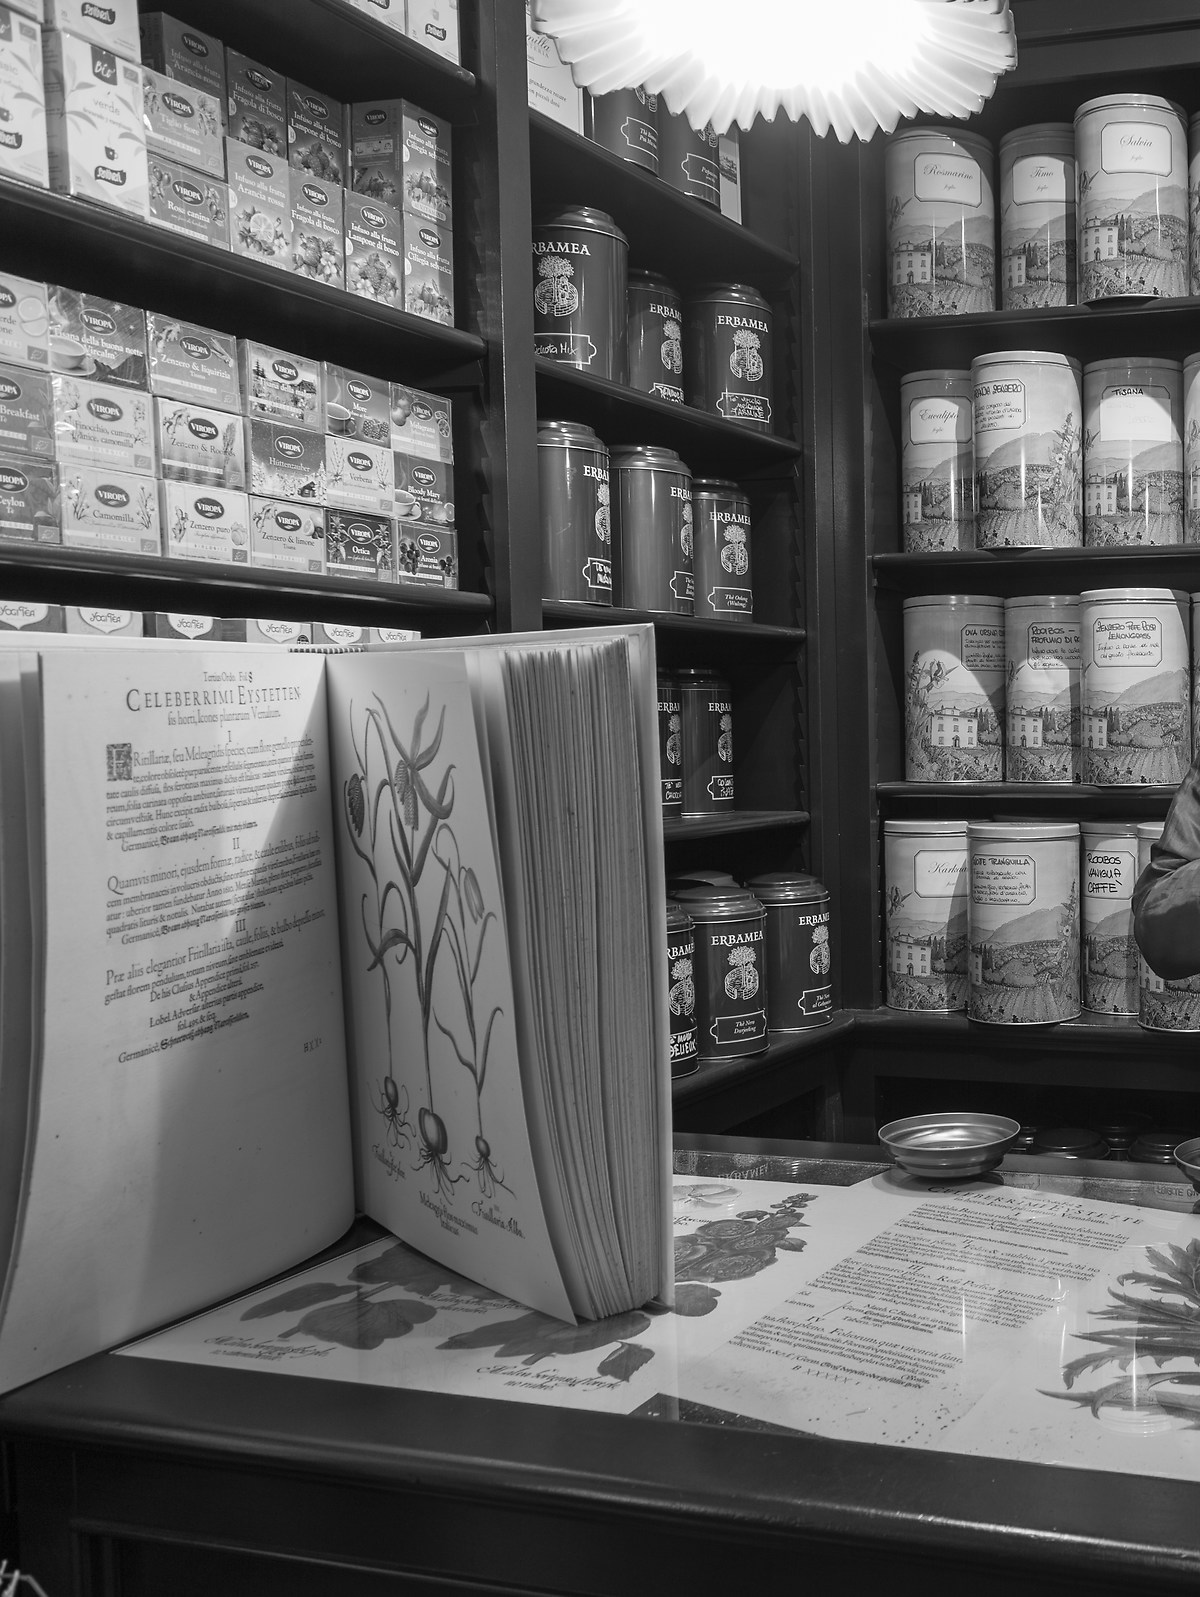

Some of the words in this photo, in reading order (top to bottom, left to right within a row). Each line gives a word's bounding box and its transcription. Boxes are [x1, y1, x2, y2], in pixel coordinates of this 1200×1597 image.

[165, 96, 192, 114] VIROPA
[291, 119, 318, 138] Lampone
[326, 134, 341, 148] bosco
[1120, 135, 1152, 147] Salvia
[248, 159, 271, 173] VIROPA
[924, 164, 973, 180] Rosmarino
[1030, 166, 1053, 178] Timo
[174, 184, 201, 200] VIROPA
[238, 184, 266, 200] Arancia
[303, 186, 326, 201] VIROPA
[168, 201, 185, 214] Rosa
[187, 209, 209, 223] canina
[363, 209, 384, 224] VIROPA
[292, 210, 314, 225] Fragola
[323, 222, 339, 235] bosco
[351, 223, 370, 235] Infuso
[349, 230, 376, 247] Lampone
[383, 244, 399, 256] bosco
[420, 232, 439, 245] VIROPA
[410, 244, 427, 256] Infuso
[533, 242, 591, 256] RBAMEA
[408, 252, 429, 266] Ciliegia
[83, 314, 112, 329] VIROPA
[718, 316, 768, 332] ERBAMEA
[81, 336, 100, 346] della
[102, 339, 123, 351] buona
[182, 340, 208, 354] VIROPA
[160, 354, 190, 368] Zenzero
[202, 365, 231, 380] liquirizia
[274, 363, 296, 376] VIROPA
[350, 384, 369, 396] VIROPA
[0, 405, 40, 421] Breakfast
[90, 403, 120, 416] VIROPA
[191, 423, 216, 435] VIROPA
[101, 435, 133, 448] camomilla
[172, 437, 198, 450] Zenzero
[278, 441, 300, 453] VIROPA
[350, 456, 371, 466] VIROPA
[350, 473, 372, 483] Verbena
[414, 470, 433, 480] VIROPA
[98, 490, 126, 502] VIROPA
[408, 486, 426, 496] Bloody
[427, 489, 440, 499] Mary
[196, 502, 222, 514] VIROPA
[92, 509, 134, 522] Camomilla
[277, 516, 299, 527] VIROPA
[190, 521, 215, 532] Zenzero
[216, 525, 230, 534] puro
[350, 529, 371, 538] VIROPA
[262, 532, 286, 543] Zenzero
[296, 536, 315, 546] limone
[420, 538, 438, 548] VIROPA
[353, 546, 370, 555] Ortica
[126, 688, 234, 712] CELEBERRIMI
[238, 685, 301, 705] EYSTETTEN
[711, 931, 763, 946] ERBAMEA
